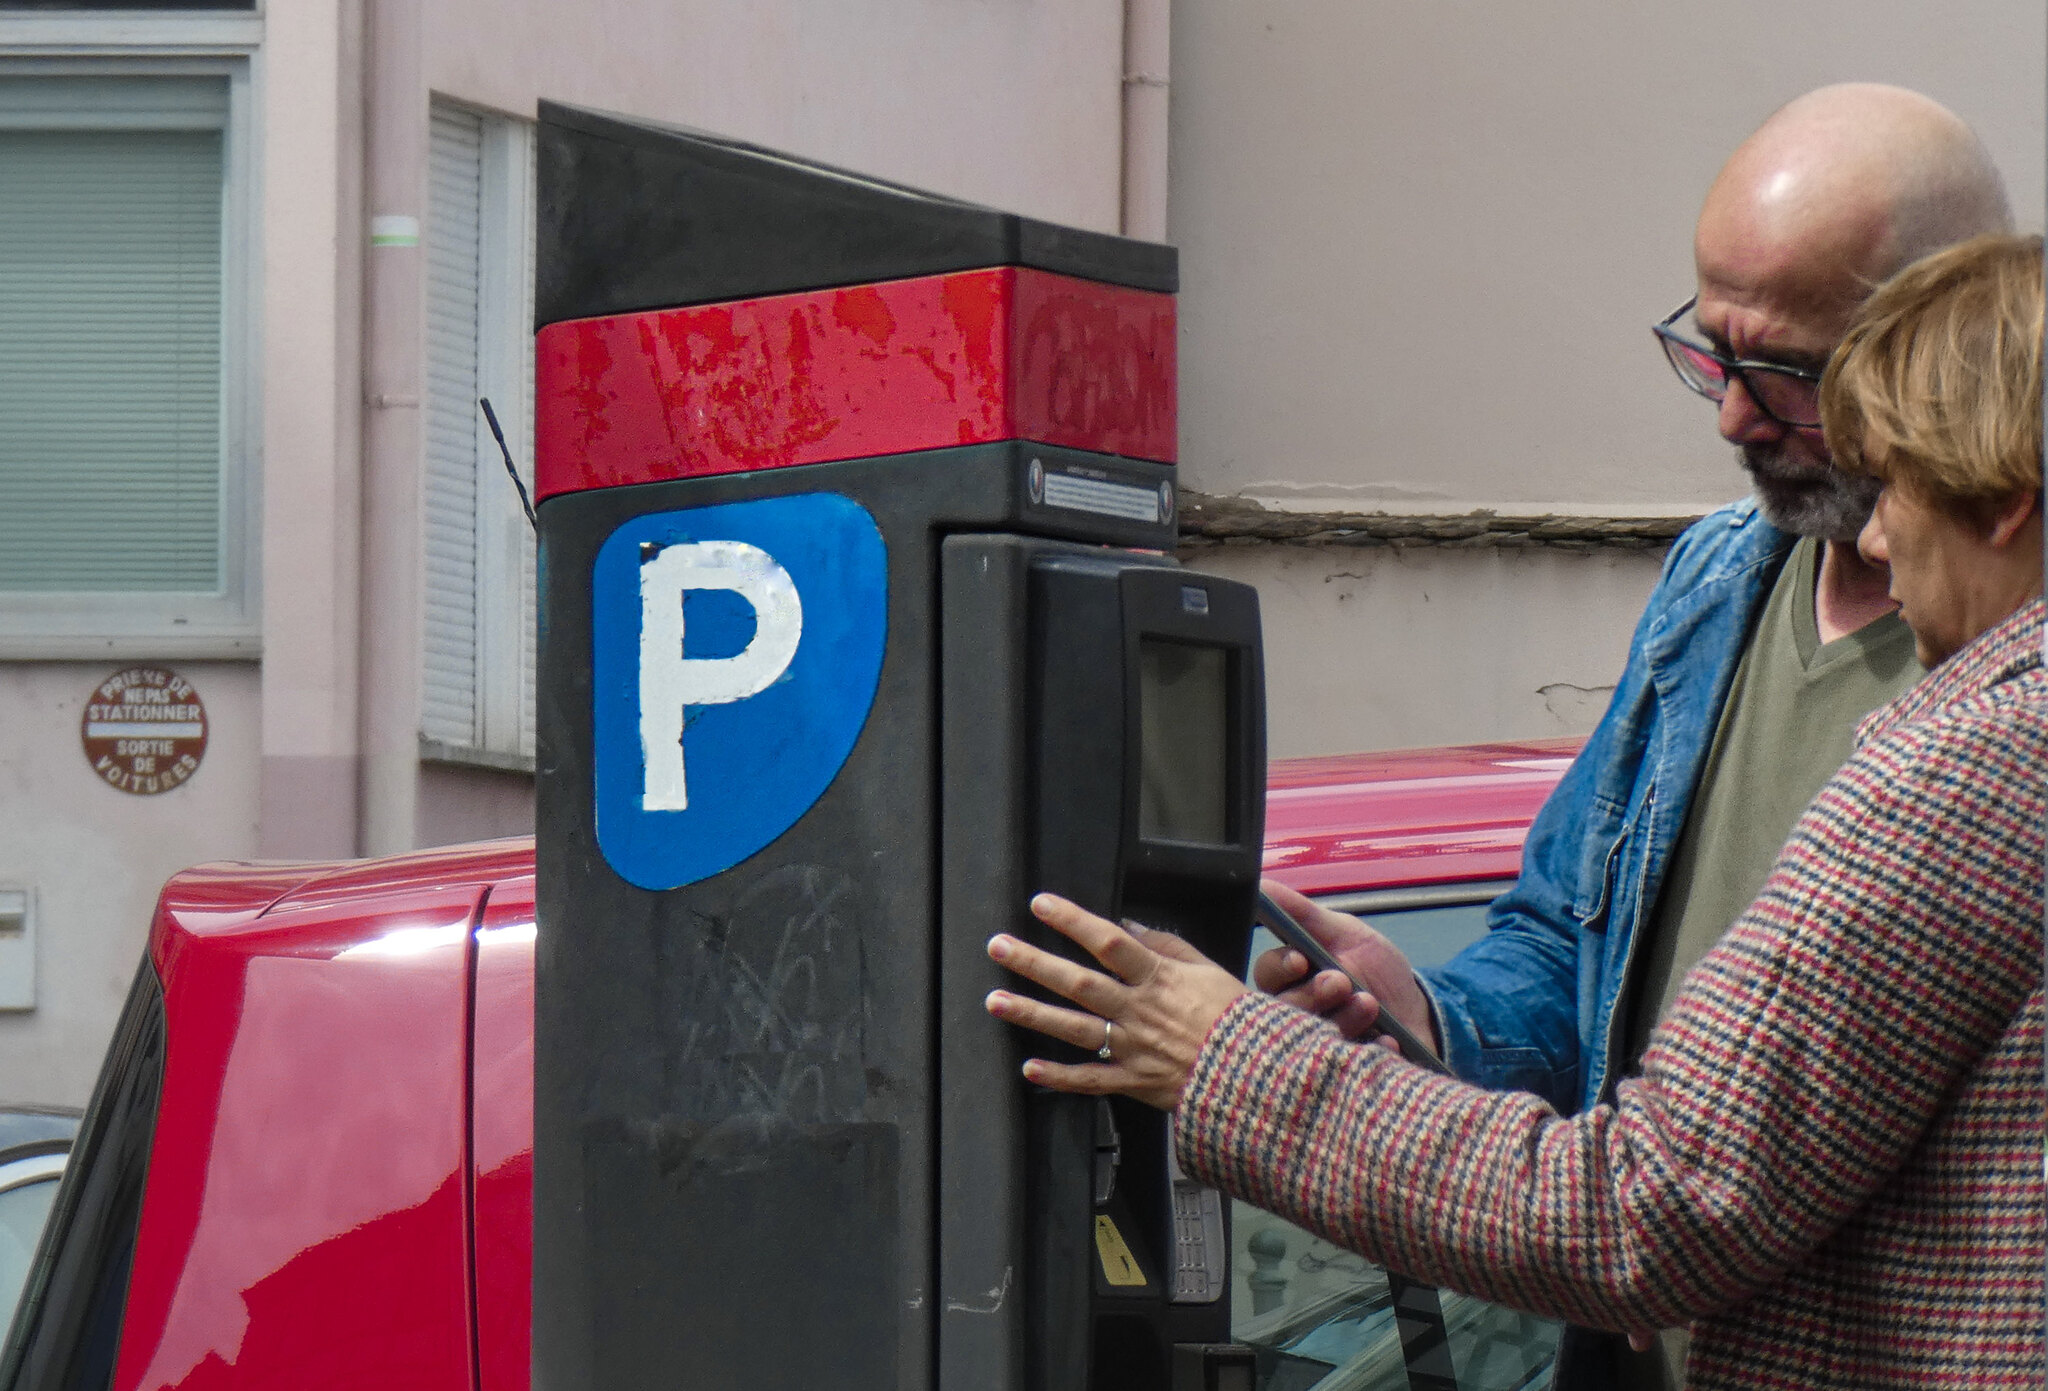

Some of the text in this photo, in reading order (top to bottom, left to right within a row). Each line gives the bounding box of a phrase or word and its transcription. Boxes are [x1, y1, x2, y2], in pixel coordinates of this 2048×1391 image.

[640, 541, 803, 812] P
[169, 675, 192, 700] DE
[89, 704, 201, 720] STATIONNER
[116, 739, 175, 756] SORTIE
[96, 754, 198, 792] VOITURES
[134, 757, 156, 773] DE
